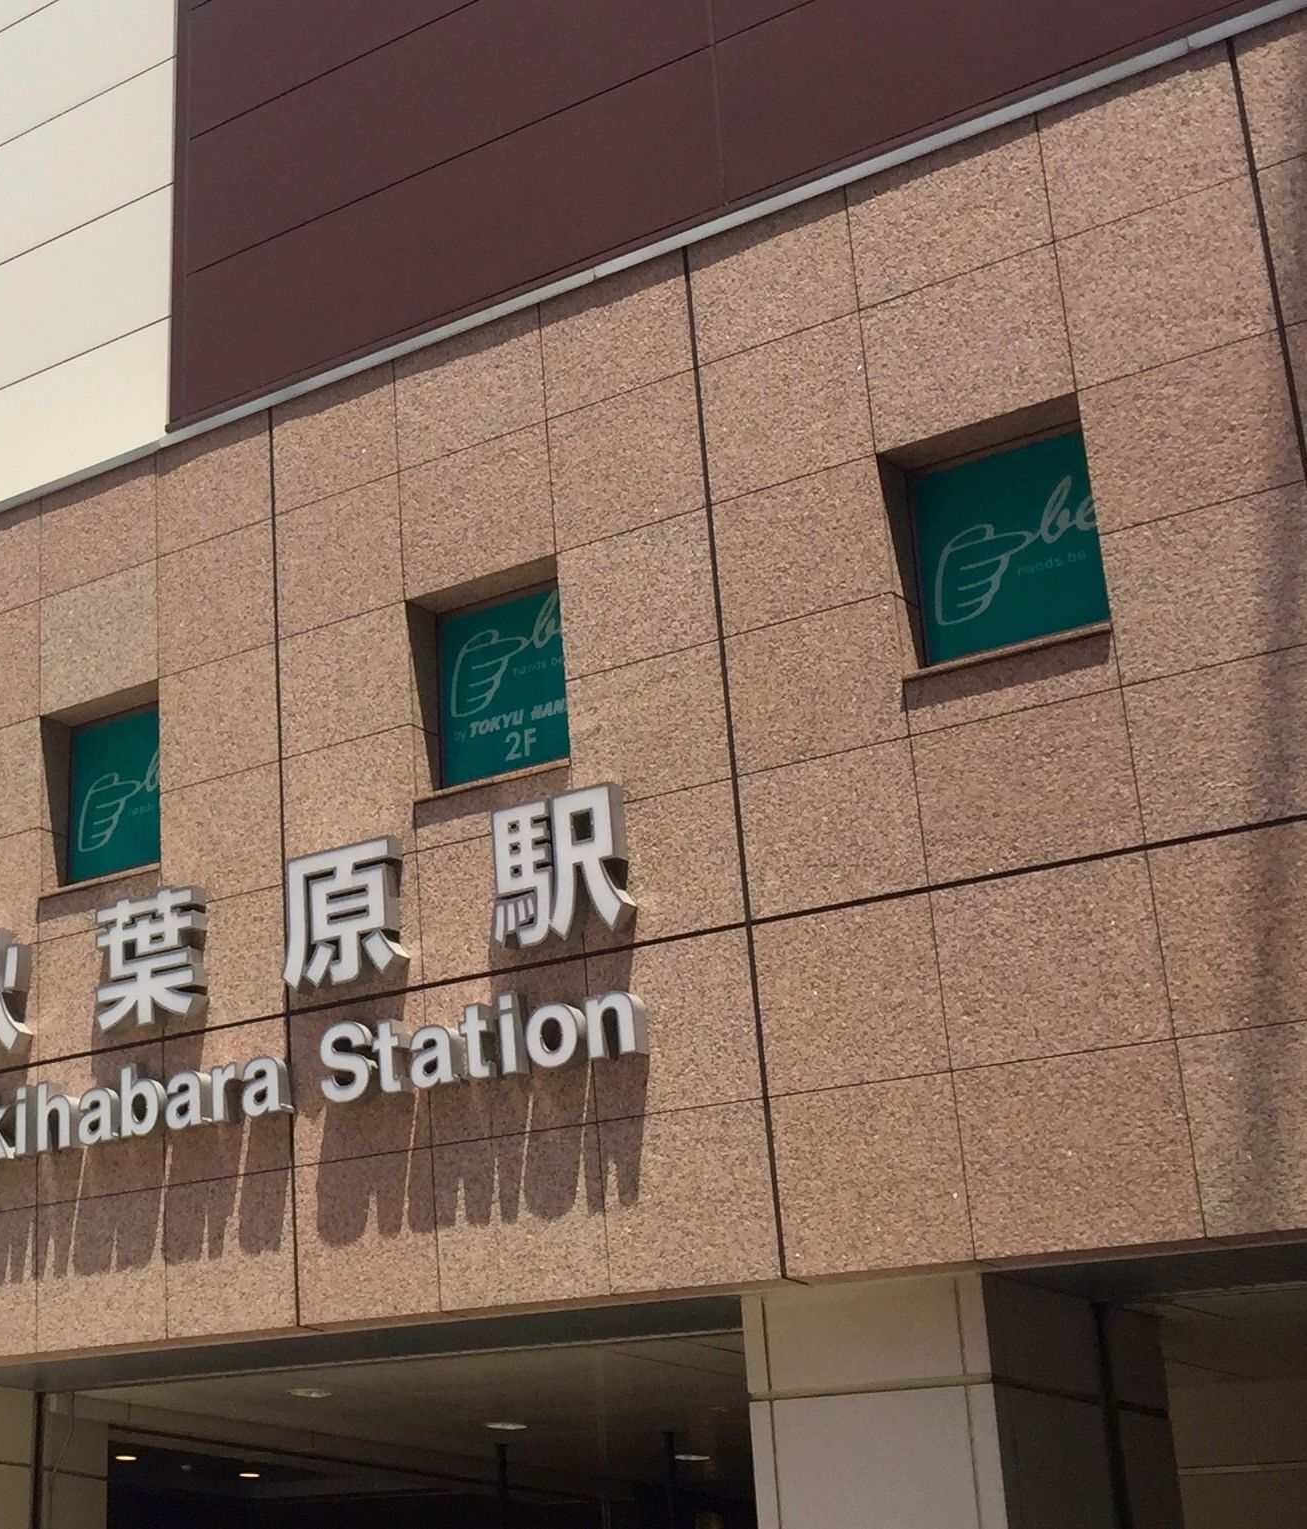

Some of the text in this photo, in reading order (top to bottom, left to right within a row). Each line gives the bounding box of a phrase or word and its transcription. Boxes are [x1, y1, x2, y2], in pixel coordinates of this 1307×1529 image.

[469, 709, 524, 738] TOKYU
[505, 728, 537, 761] 2F
[320, 991, 643, 1102] Station
